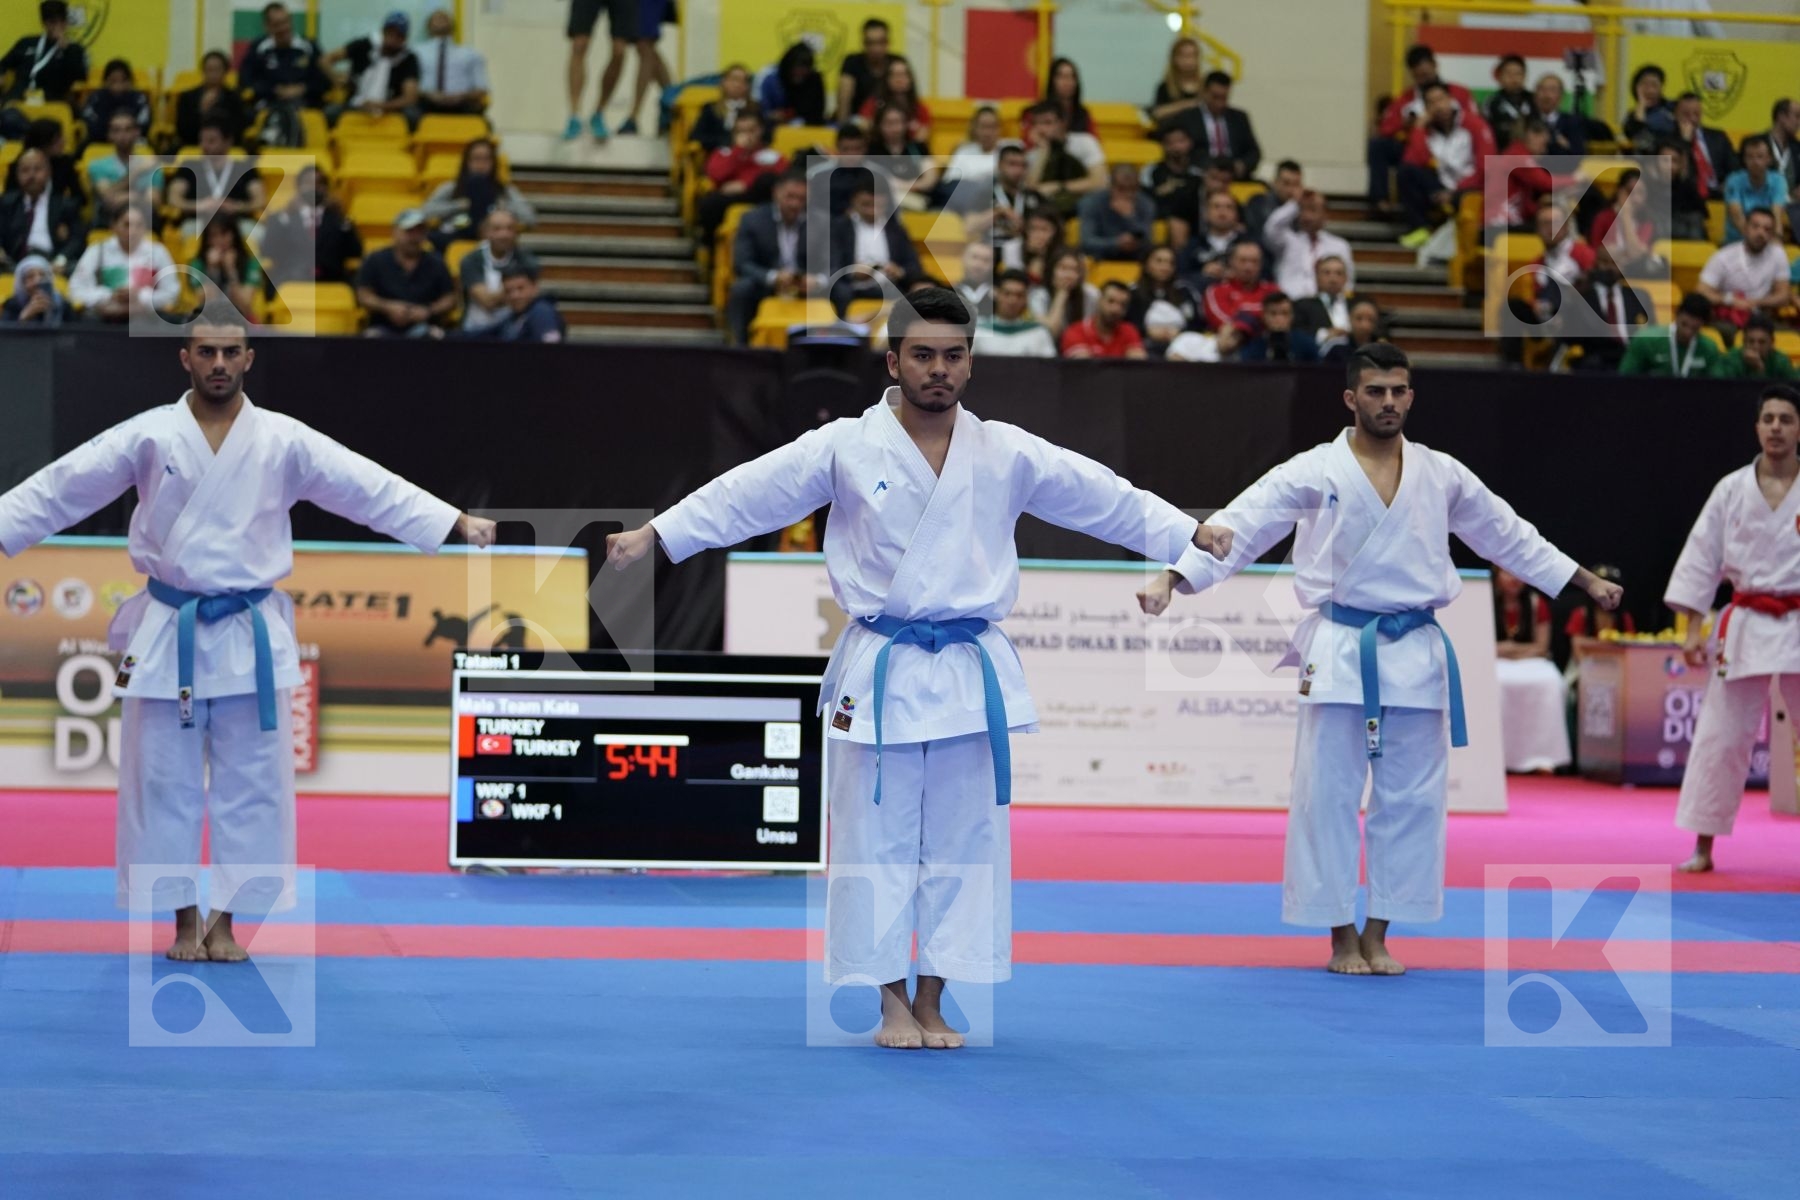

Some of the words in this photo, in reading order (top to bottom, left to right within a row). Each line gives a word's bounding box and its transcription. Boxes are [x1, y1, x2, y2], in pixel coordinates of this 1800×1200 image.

[455, 653, 508, 670] Tatami
[510, 654, 520, 670] 1
[498, 698, 541, 715] Team
[543, 699, 580, 716] Kata
[477, 718, 545, 735] TURKEY
[513, 739, 581, 756] TURKEY
[605, 744, 677, 780] 5:44
[475, 782, 515, 799] WKF
[516, 783, 527, 800] 1
[511, 803, 551, 820] WKF
[552, 803, 562, 820] 1
[756, 828, 798, 845] Unsu
